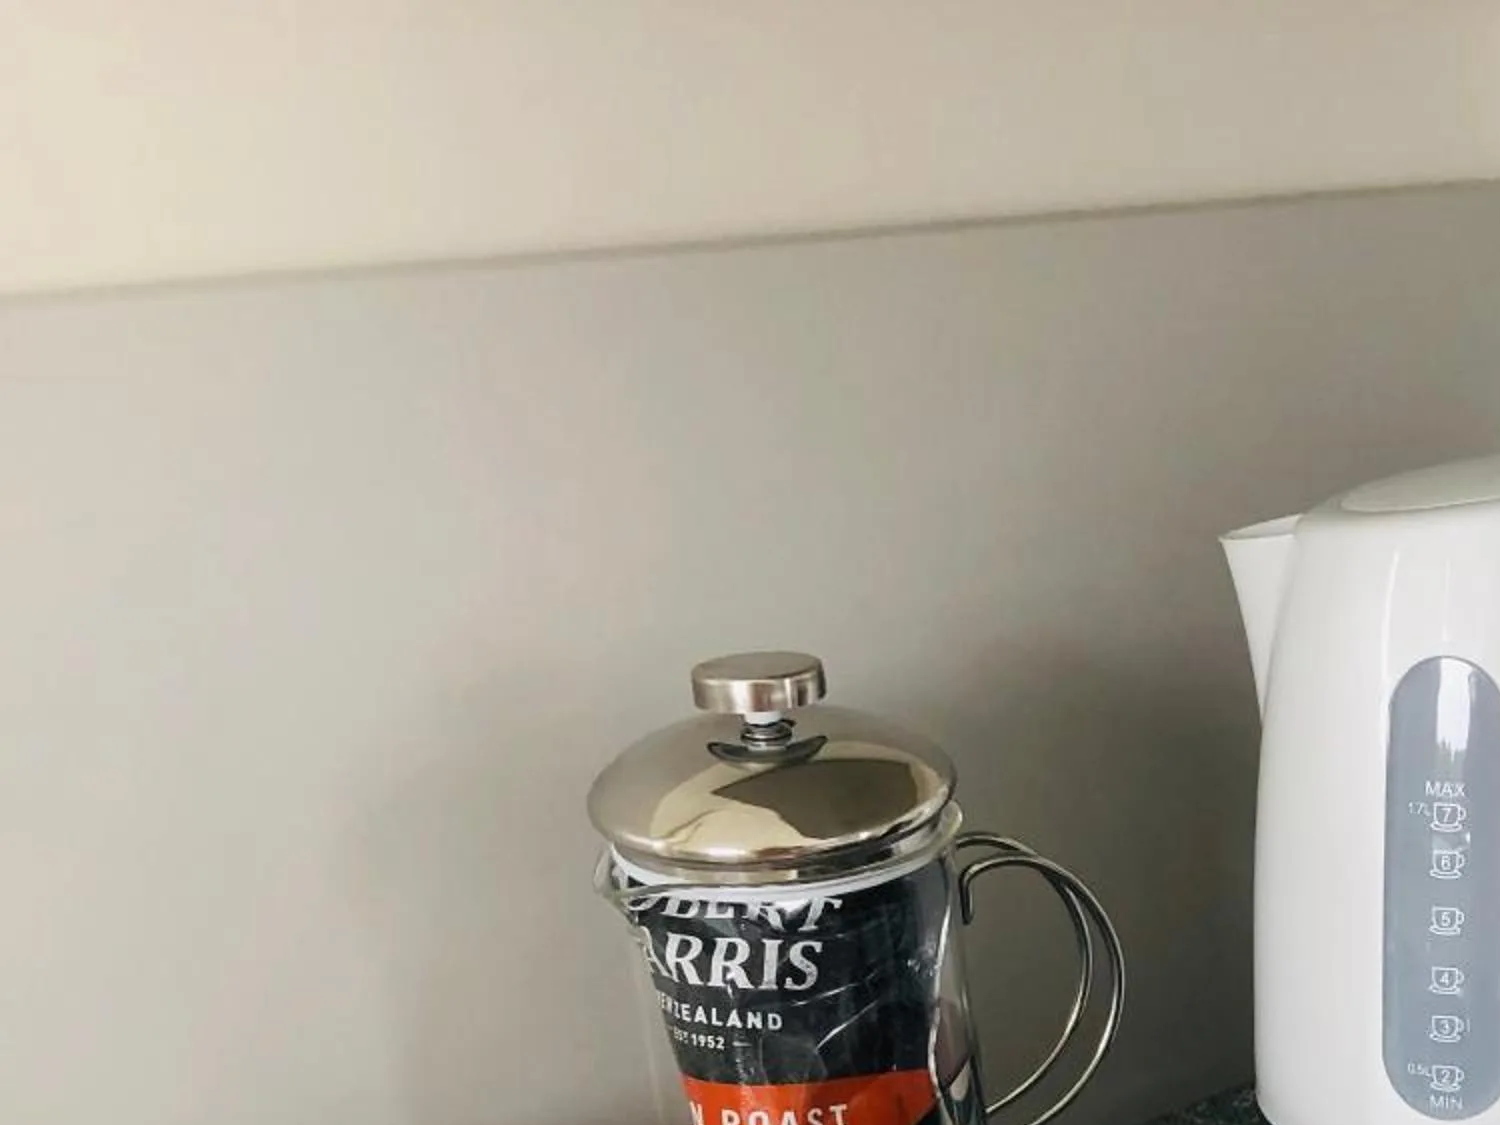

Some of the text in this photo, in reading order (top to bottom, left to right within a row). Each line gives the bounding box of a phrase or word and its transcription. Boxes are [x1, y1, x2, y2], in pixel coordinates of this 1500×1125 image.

[1425, 780, 1466, 797] MAX
[691, 1033, 725, 1050] 1952
[1430, 1094, 1463, 1110] MIN
